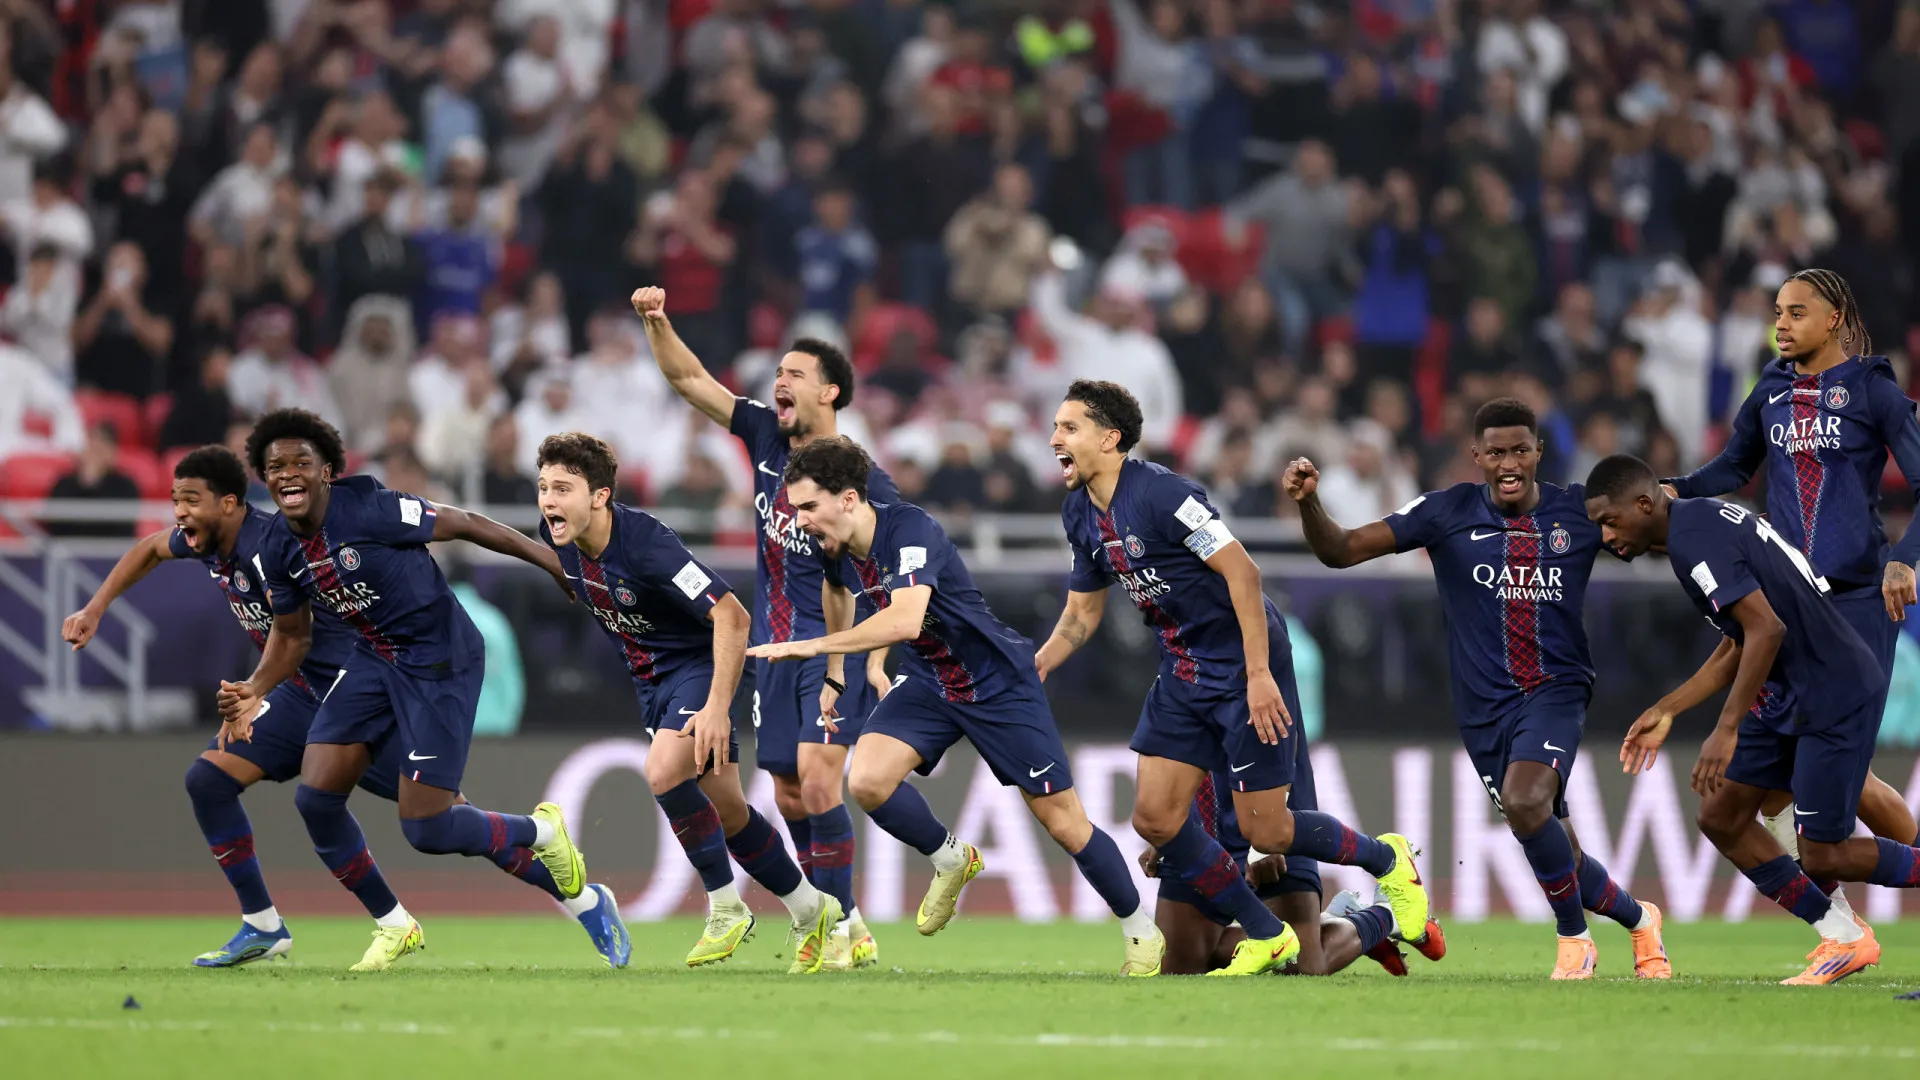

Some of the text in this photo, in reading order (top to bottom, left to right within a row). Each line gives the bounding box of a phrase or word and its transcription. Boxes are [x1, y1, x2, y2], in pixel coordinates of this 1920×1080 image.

[1770, 416, 1841, 447] QATAR
[1785, 436, 1841, 457] AIRWAYS
[763, 522, 812, 556] AIRWAYS
[1472, 564, 1563, 589] QATAR
[1495, 587, 1563, 601] AIRWAYS
